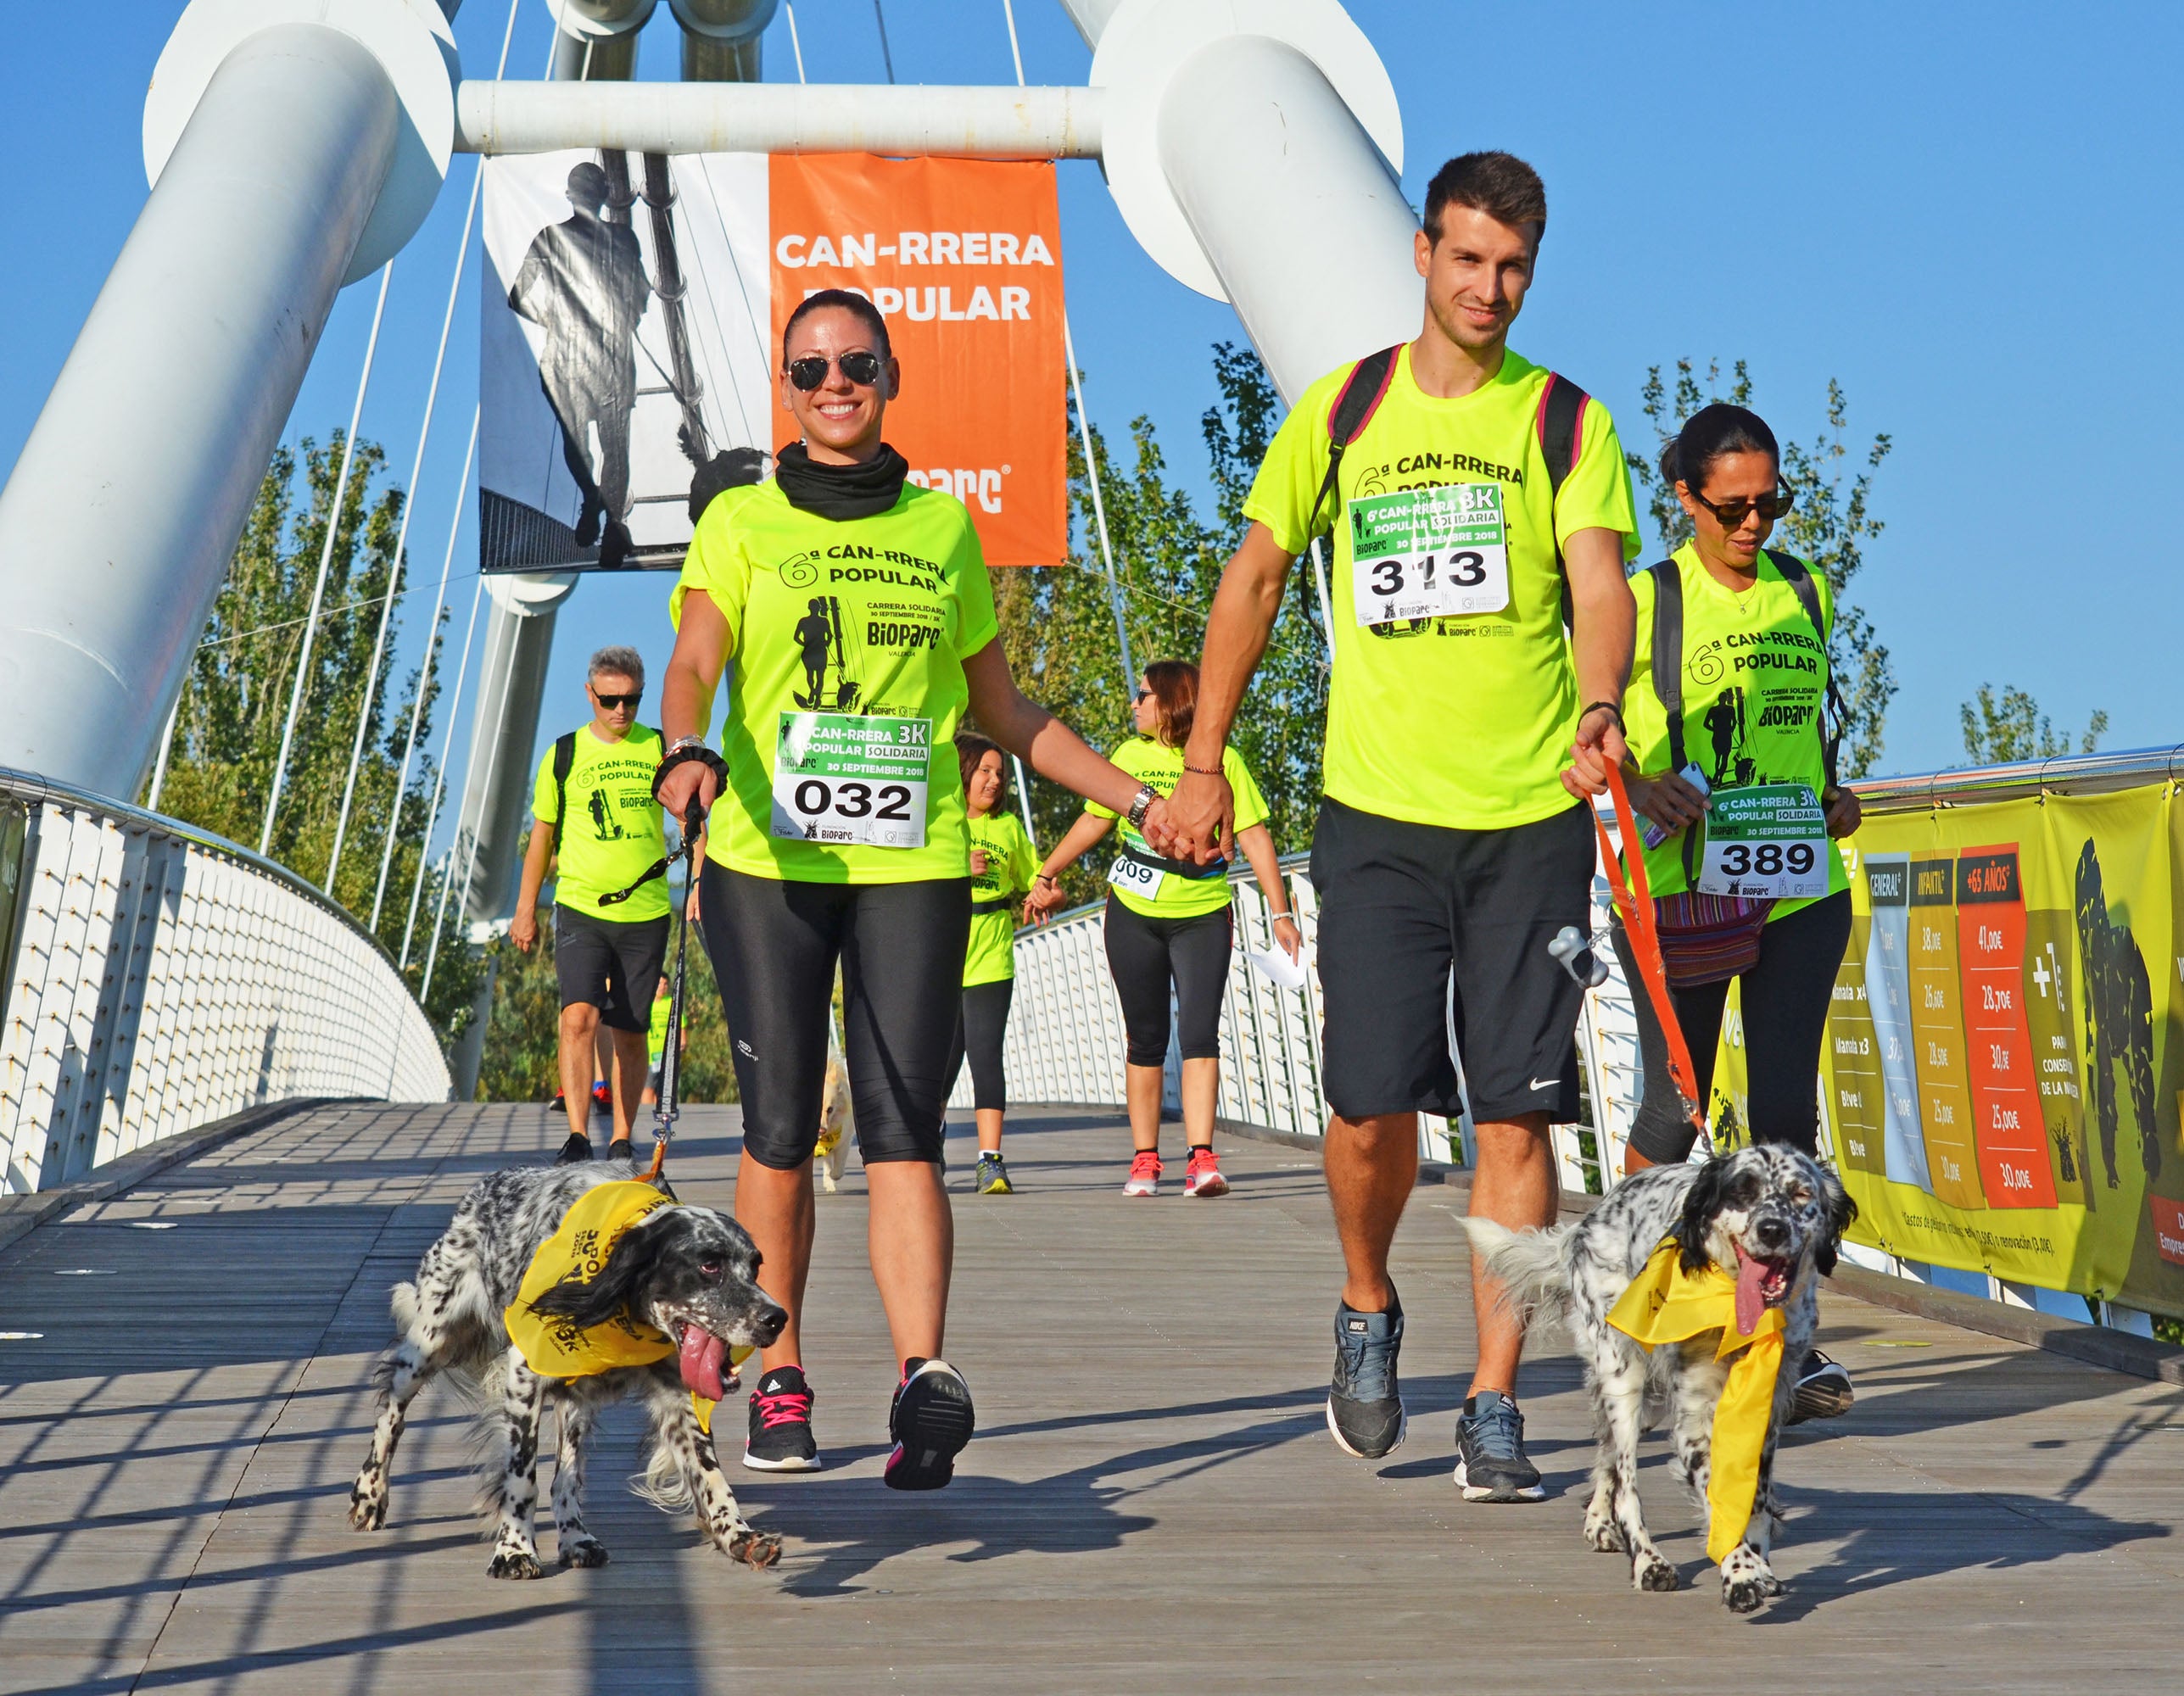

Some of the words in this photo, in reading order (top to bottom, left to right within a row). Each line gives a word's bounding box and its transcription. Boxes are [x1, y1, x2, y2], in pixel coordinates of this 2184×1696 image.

[776, 232, 1054, 269] CAN-RRERA
[804, 286, 1031, 321] PULAR
[1397, 453, 1523, 488] CAN-RRERA
[1378, 499, 1456, 520] CAN-RRERA
[1374, 519, 1428, 535] POPULAR
[1434, 513, 1496, 527] SOLIDARIA
[1474, 531, 1497, 540] 2018
[827, 544, 951, 586] CAN-RRERA
[1371, 551, 1487, 595] 313
[829, 568, 939, 595] POPULAR
[908, 604, 946, 616] SOLIDARIA
[1726, 632, 1824, 658] CAN-RRERA
[1734, 654, 1818, 675] POPULAR
[812, 727, 892, 743] CAN-RRERA
[898, 723, 926, 745] 3K
[805, 742, 862, 756] POPULAR
[868, 747, 925, 759] SOLIDARIA
[600, 772, 651, 782] POPULAR
[827, 762, 840, 771] 30
[842, 762, 904, 775] SEPTIEMBRE
[906, 767, 924, 776] 2018
[1142, 771, 1184, 779] CAN-RR
[795, 779, 912, 821] 032
[1730, 796, 1796, 809] CAN-RRERA
[1800, 789, 1818, 807] 3K
[1728, 812, 1773, 822] POPULAR
[1778, 810, 1822, 820] SOLIDARIA
[1759, 828, 1807, 836] SEPTIEMBRE
[971, 838, 1008, 861] N-RRERA
[1720, 843, 1815, 876] 389
[1116, 859, 1153, 884] 009
[1870, 873, 1899, 897] GENERAL
[1918, 870, 1944, 895] INFANTIL
[1967, 868, 1981, 892] +65
[1984, 860, 2008, 893] AÑOS
[1978, 925, 2003, 953] 41,00€
[1981, 985, 2012, 1013] 28,70€
[1859, 1037, 1869, 1055] x3
[2041, 1082, 2052, 1096] DE
[2052, 1081, 2064, 1096] LA
[1992, 1103, 2021, 1132] 25,00€
[2000, 1163, 2033, 1191] 30,00€
